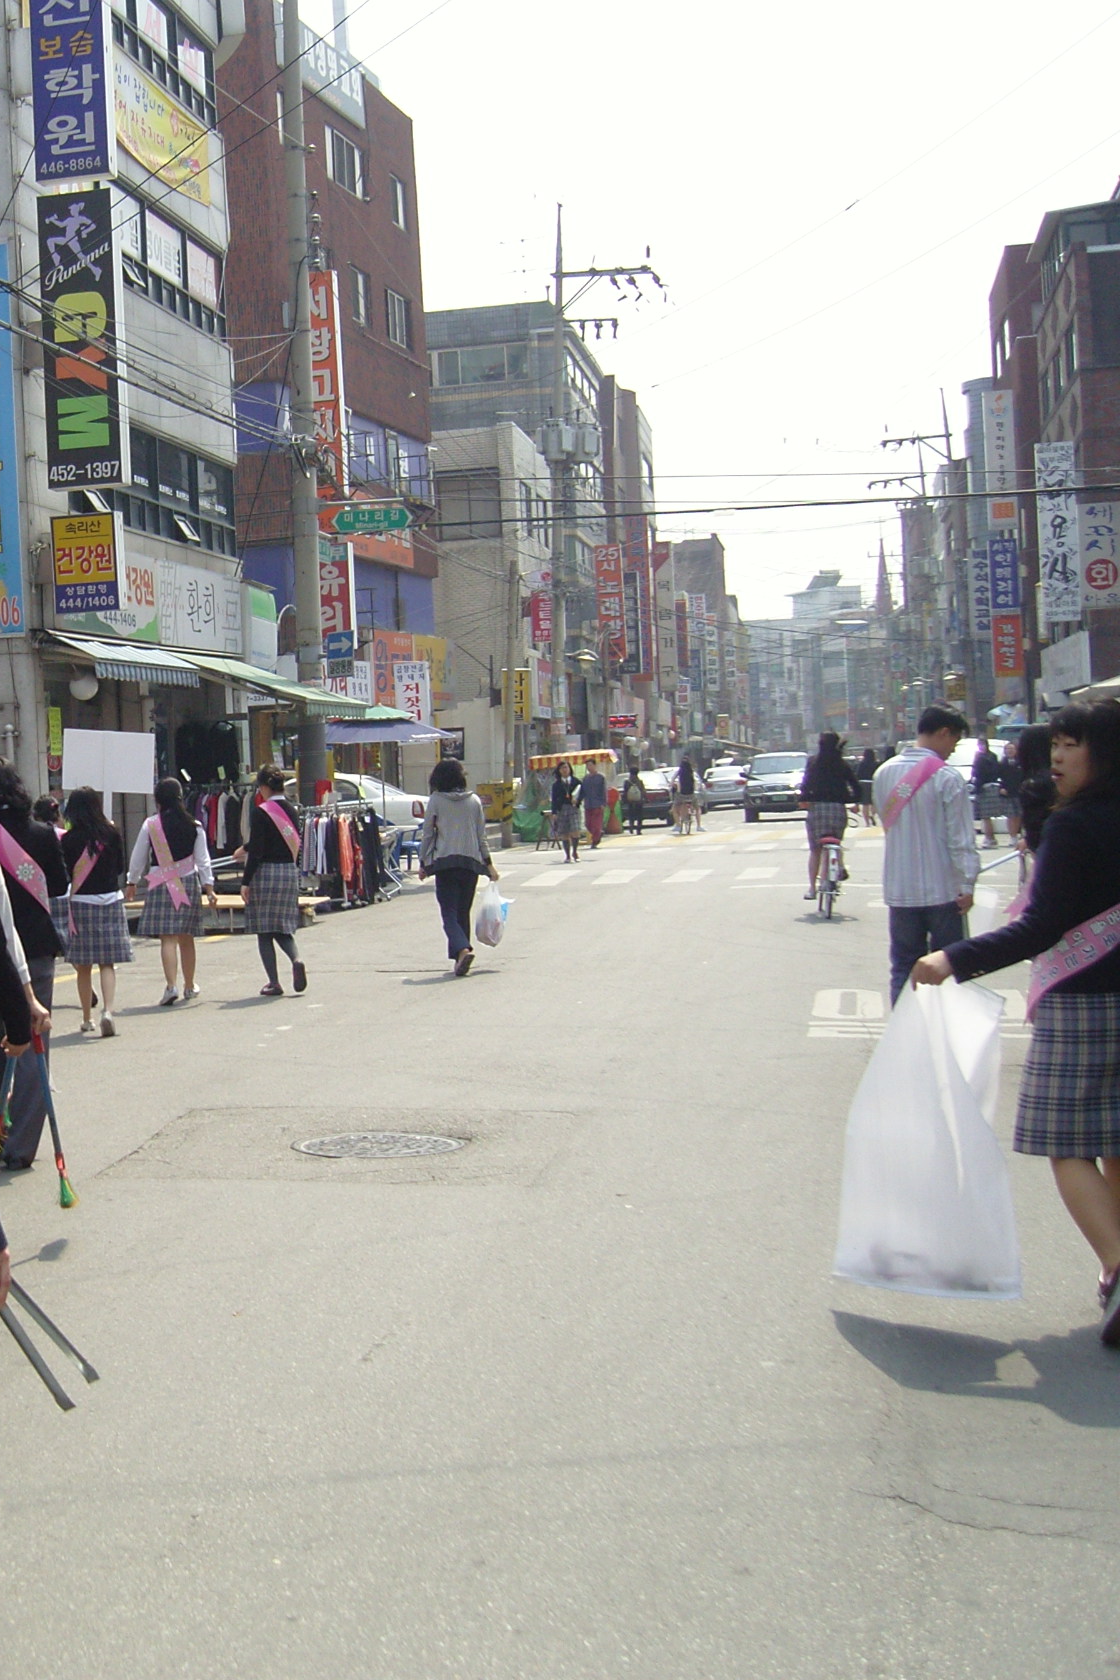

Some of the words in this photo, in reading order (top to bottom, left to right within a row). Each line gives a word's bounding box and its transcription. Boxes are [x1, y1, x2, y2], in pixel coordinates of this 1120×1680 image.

[39, 30, 94, 60] 보습
[43, 63, 100, 156] 학원
[40, 155, 102, 175] 446-8864
[44, 241, 111, 292] Panama
[48, 459, 120, 483] 452-1397
[64, 519, 103, 535] 속리산
[343, 509, 400, 523] 미나리길
[55, 543, 113, 575] 건강원
[1090, 562, 1116, 586] 회
[59, 595, 116, 610] 444/1406
[186, 578, 217, 637] 환희
[598, 576, 624, 640] 노래방
[329, 661, 353, 675] 일방통행
